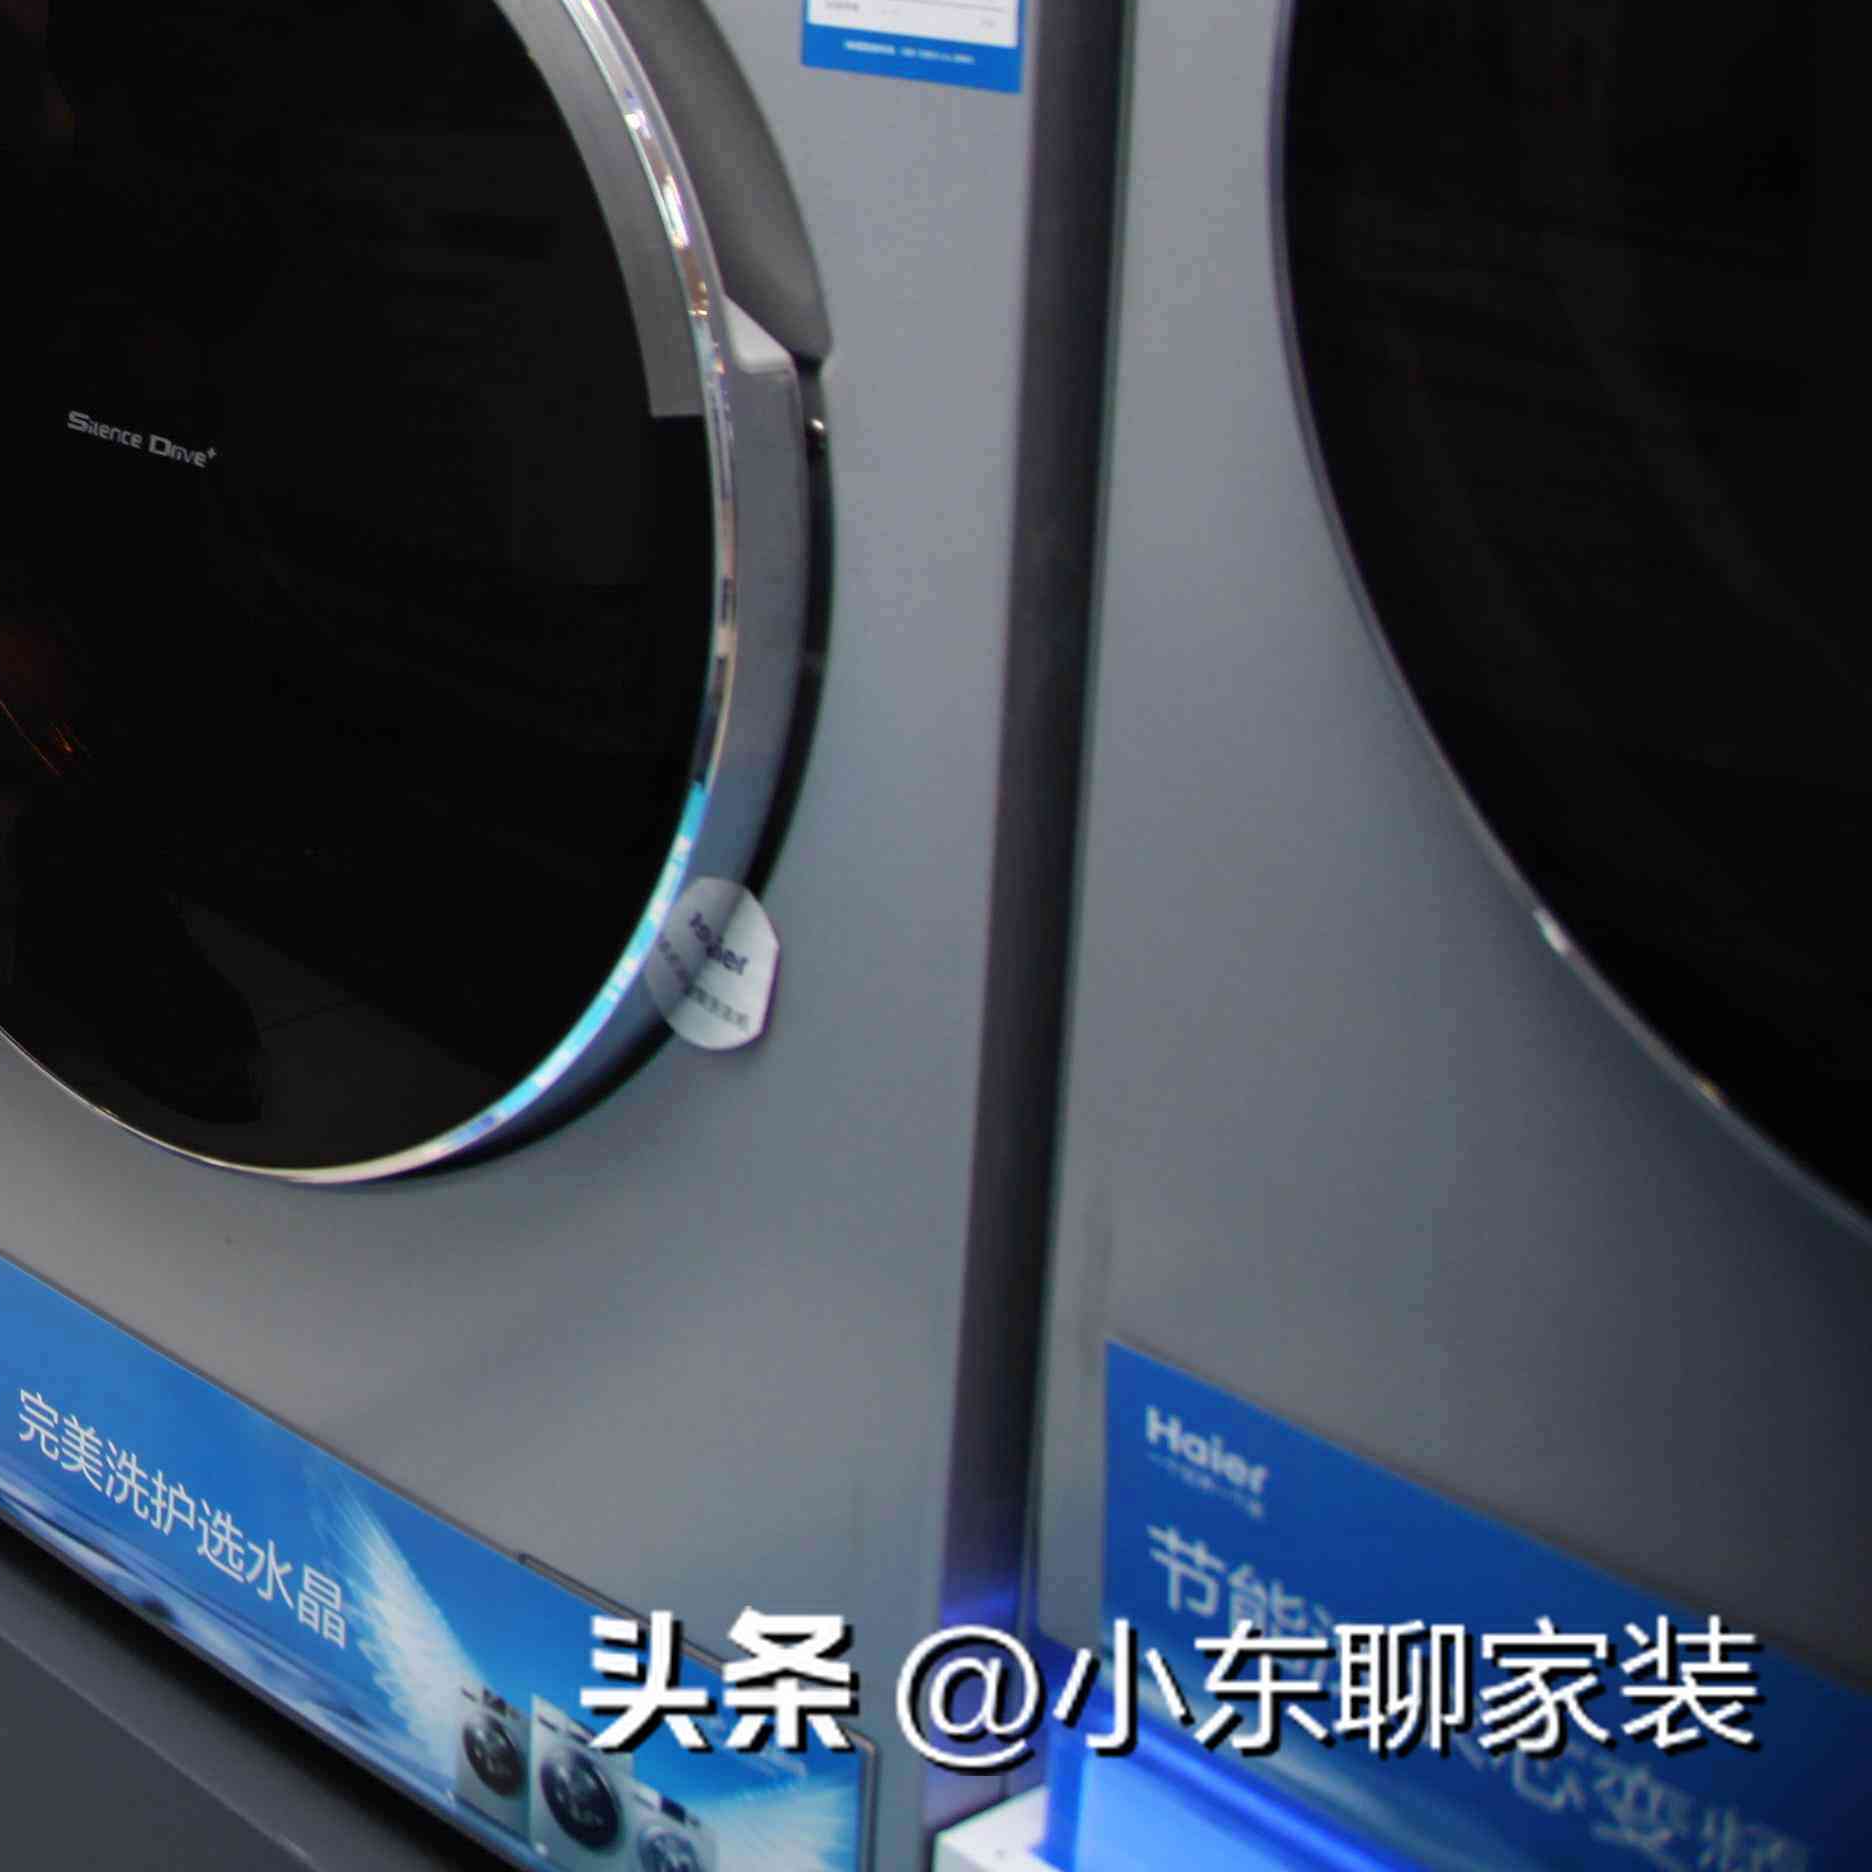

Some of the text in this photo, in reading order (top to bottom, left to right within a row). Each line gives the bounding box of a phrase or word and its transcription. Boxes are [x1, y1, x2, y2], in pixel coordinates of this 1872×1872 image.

[67, 410, 143, 448] Silence
[1146, 1404, 1268, 1494] Haier
[17, 1387, 348, 1649] 完美洗护选水晶
